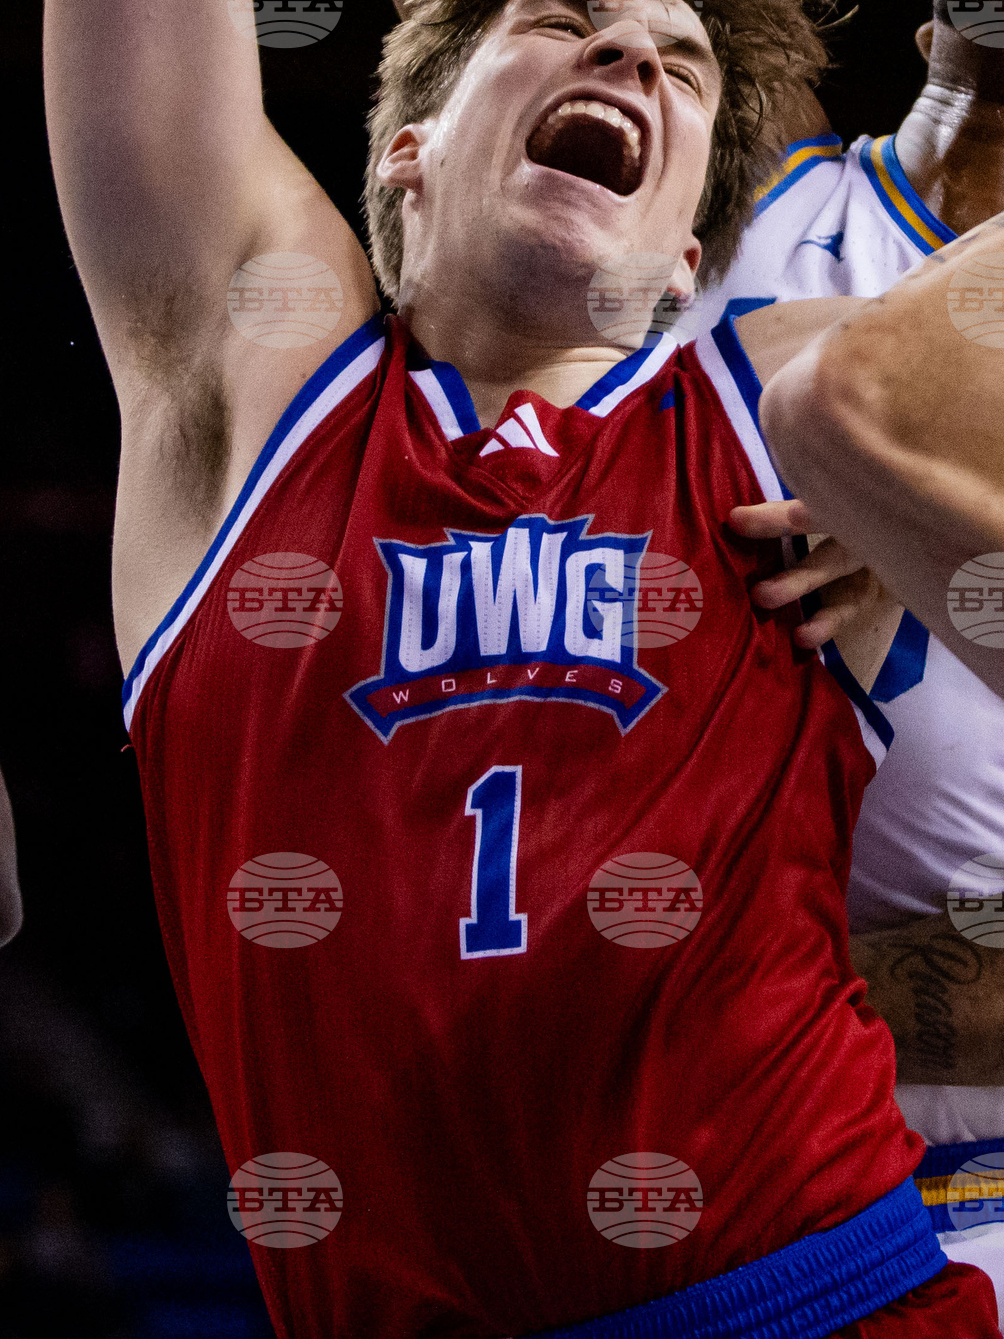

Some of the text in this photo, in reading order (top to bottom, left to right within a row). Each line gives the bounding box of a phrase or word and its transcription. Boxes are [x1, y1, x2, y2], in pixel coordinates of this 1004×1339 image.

[397, 526, 625, 673] UWG
[392, 667, 623, 704] WOLVES
[459, 764, 528, 960] 1
